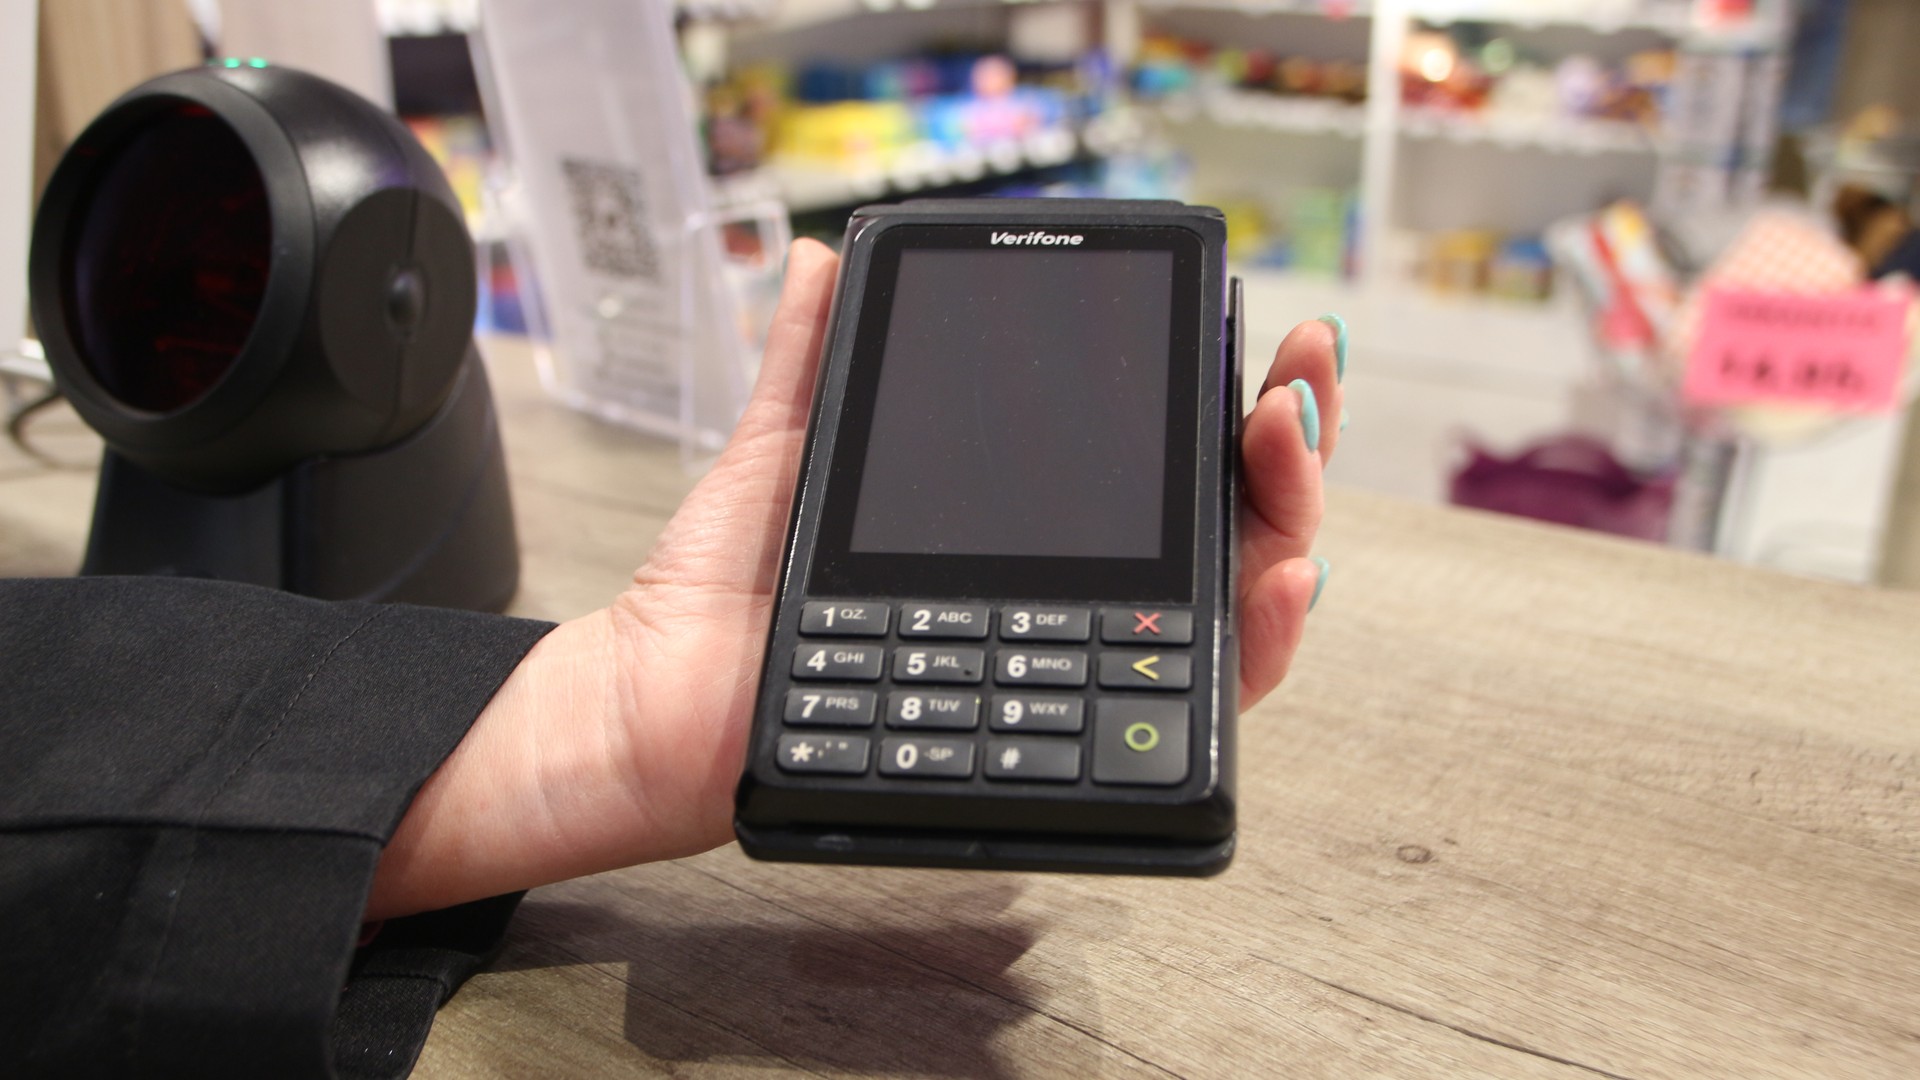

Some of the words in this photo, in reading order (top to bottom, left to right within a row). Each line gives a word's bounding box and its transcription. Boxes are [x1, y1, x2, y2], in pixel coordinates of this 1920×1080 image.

[990, 231, 1084, 245] Verifone
[822, 606, 836, 627] 1
[911, 609, 931, 631] 2
[937, 611, 973, 624] ABC
[1011, 611, 1031, 634] 3
[1036, 613, 1068, 626] DEF
[806, 650, 827, 672] 4
[833, 651, 865, 664] GHI
[906, 653, 926, 675] 5
[932, 655, 960, 668] JKL
[1007, 655, 1028, 678] 6
[1031, 657, 1072, 671] MNO
[801, 695, 821, 719] 7
[825, 697, 860, 710] PRS
[900, 696, 922, 721] 8
[929, 698, 961, 712] TUV
[1002, 699, 1024, 725] 9
[1029, 702, 1070, 715] WXY
[895, 743, 918, 770] 0
